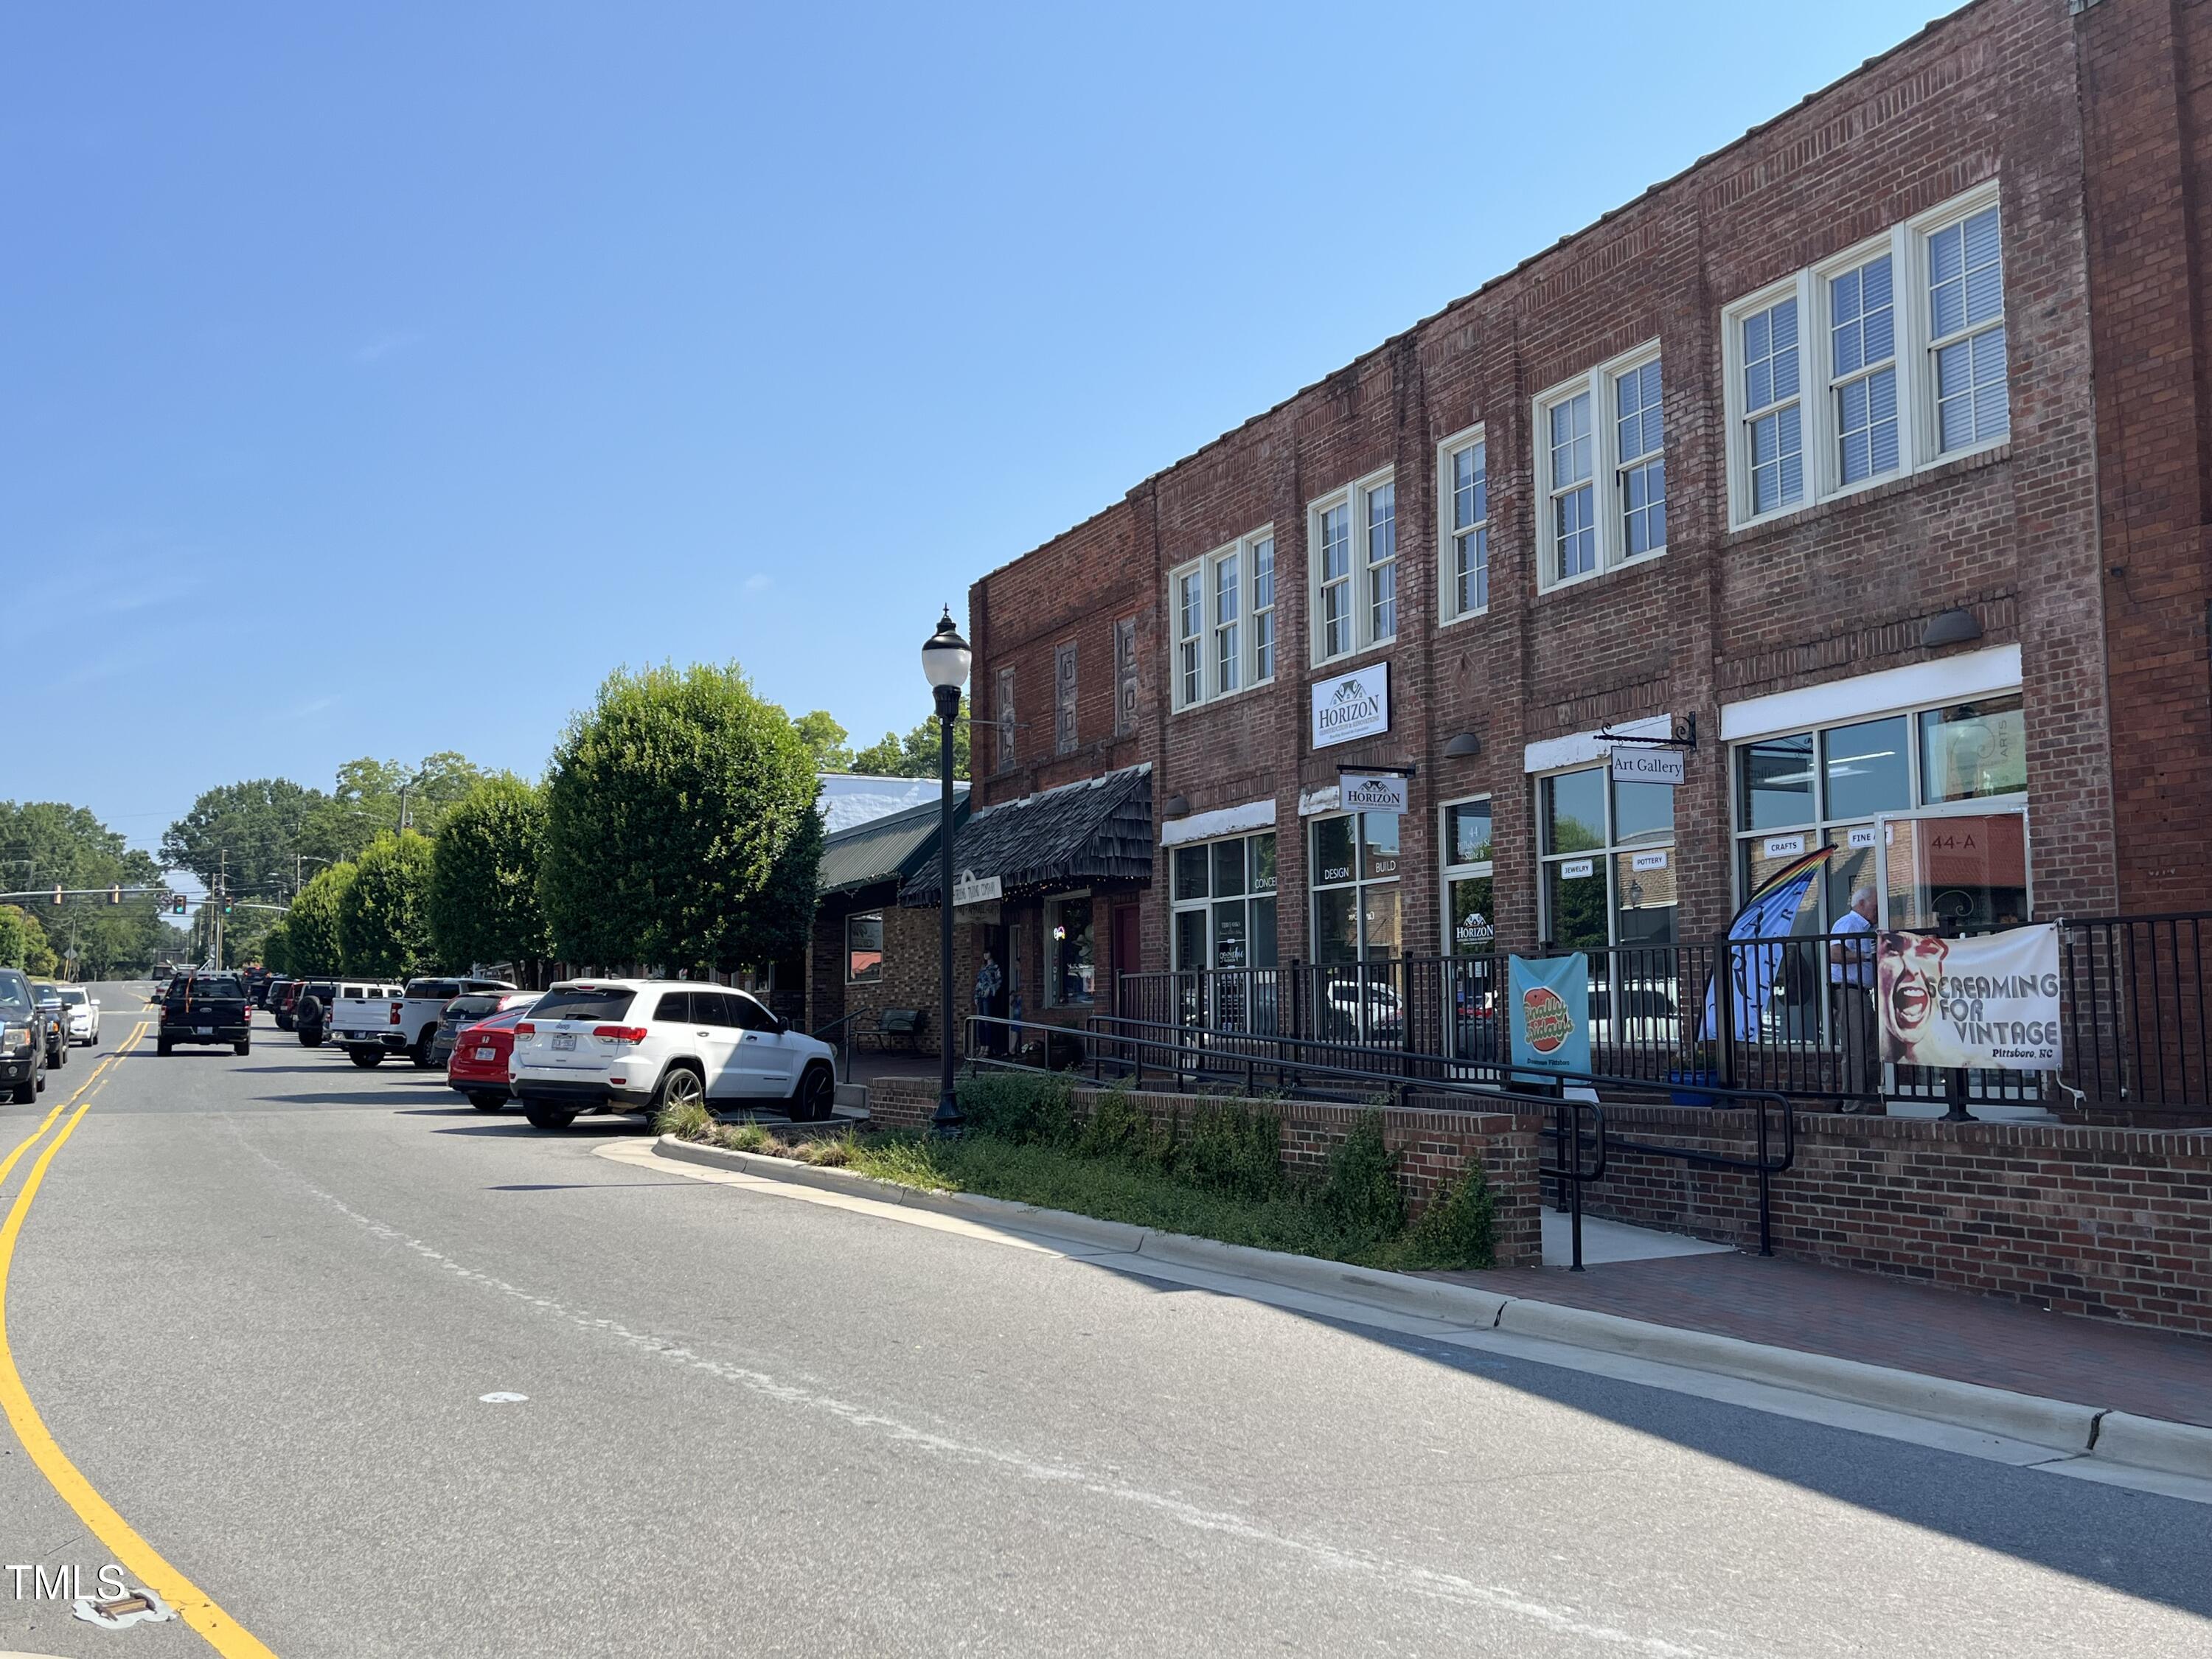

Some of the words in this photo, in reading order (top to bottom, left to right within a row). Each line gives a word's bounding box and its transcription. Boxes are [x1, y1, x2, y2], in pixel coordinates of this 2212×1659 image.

[1319, 695, 1379, 728] HORIZON
[1999, 720, 2008, 757] ARTS
[1614, 758, 1633, 771] Art
[1637, 759, 1682, 776] Gallery
[1348, 790, 1400, 804] HORIZON
[1852, 833, 1871, 842] FINE
[1932, 834, 1976, 849] 44-A
[1771, 841, 1798, 851] CRAFTS
[1375, 860, 1396, 873] BUILD
[1637, 856, 1663, 865] POTTERY
[1324, 867, 1349, 880] DESIGN
[1565, 865, 1589, 874] JEWELRY
[1255, 876, 1277, 888] CONCE
[1456, 925, 1494, 939] HORIZON
[1927, 973, 2059, 999] SCREAMING
[1939, 999, 1983, 1021] FOR
[1954, 1021, 2058, 1046] VINTAGE
[1992, 1048, 2037, 1059] Pittsboro,
[2039, 1049, 2053, 1058] NC
